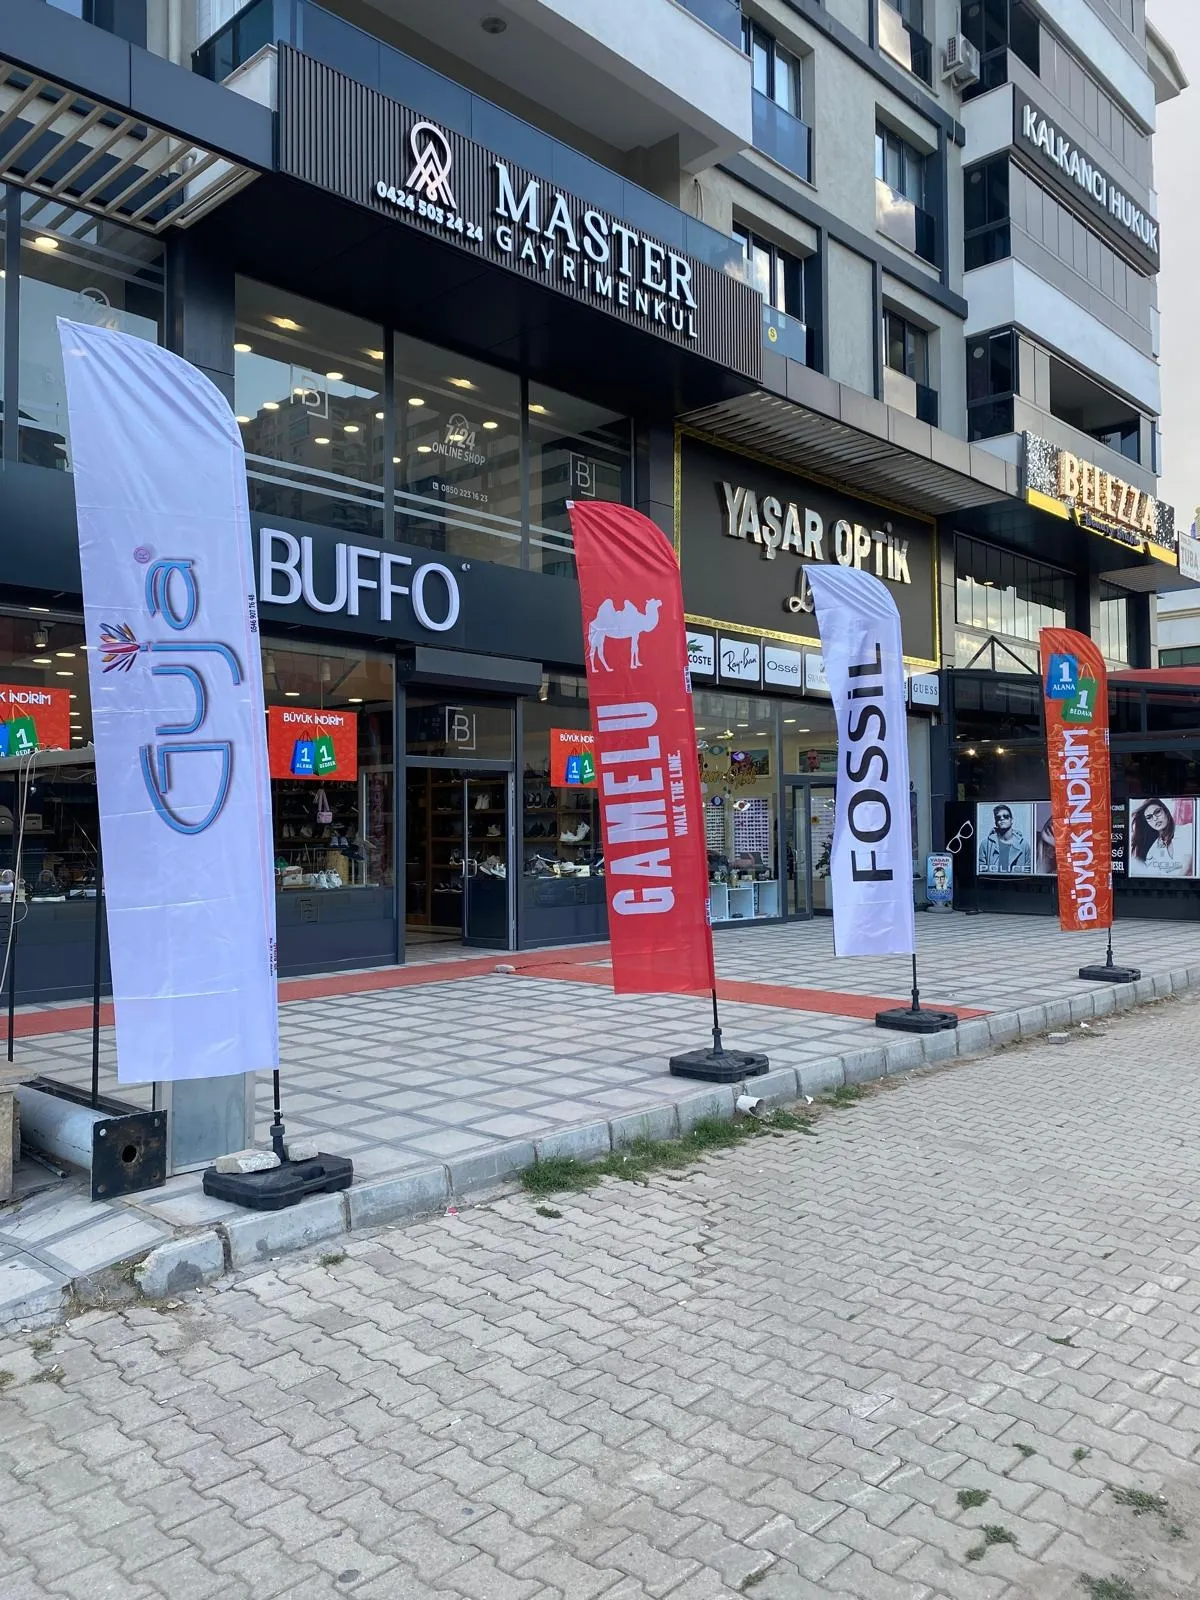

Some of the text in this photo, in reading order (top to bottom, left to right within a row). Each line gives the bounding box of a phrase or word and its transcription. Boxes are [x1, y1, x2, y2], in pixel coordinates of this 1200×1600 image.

[1022, 104, 1159, 254] KALKANCI HUKUK
[376, 180, 484, 242] 0424 503 24 24
[494, 160, 698, 309] MASTER
[495, 225, 698, 338] GAYRİMENKUL
[444, 424, 477, 451] 7/24
[432, 441, 487, 466] ONLINE SHOP
[441, 483, 459, 495] 0850
[460, 488, 472, 499] 223
[1060, 450, 1158, 536] BELEZZA
[721, 481, 912, 585] YAŞAR OPTİK
[259, 527, 461, 632] BUFFO
[687, 653, 712, 666] COSTE
[766, 660, 799, 674] Ossé
[1059, 661, 1073, 682] 1
[8, 689, 52, 706] İNDİRİM
[913, 683, 938, 696] GUESS
[1076, 689, 1089, 709] 1
[283, 711, 344, 727] BÜYÜK İNDİRİM
[1069, 707, 1093, 718] BEDAVA
[16, 728, 33, 749] 1
[301, 747, 311, 762] 1
[319, 745, 332, 762] 1
[571, 761, 579, 774] 1
[583, 759, 593, 773] 1
[671, 779, 686, 803] THE
[597, 701, 676, 916] GAMELU
[673, 805, 689, 837] WALK
[1058, 728, 1098, 922] BÜYÜK İNDİRİM
[1111, 832, 1124, 841] ESS
[979, 865, 1032, 873] POLICE
